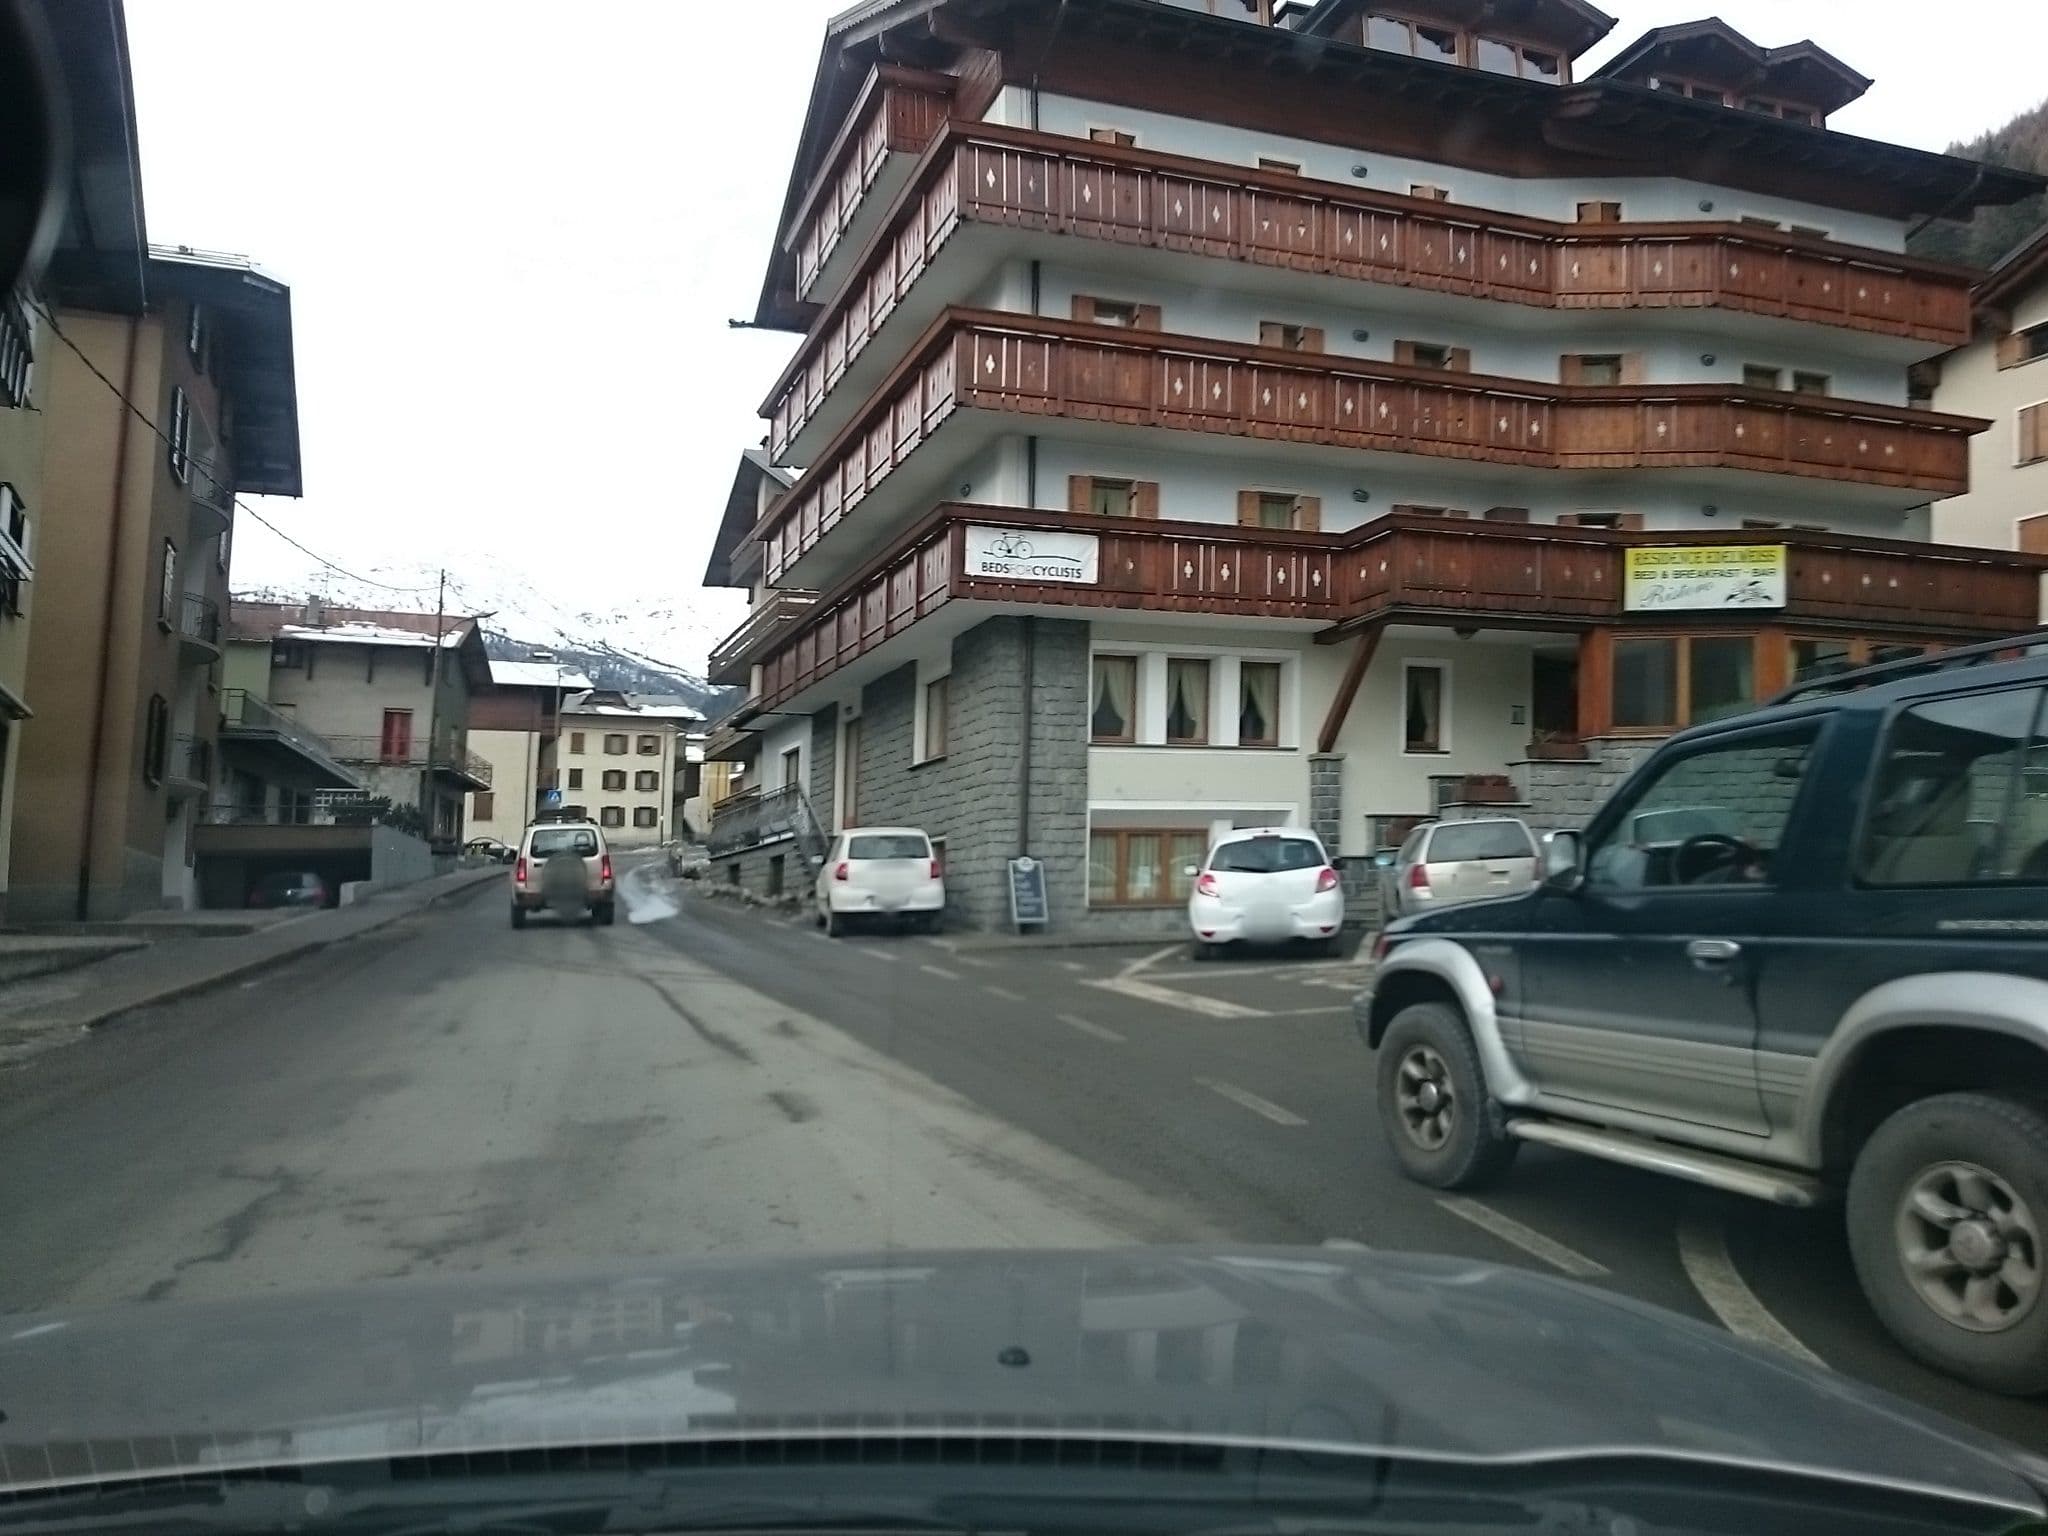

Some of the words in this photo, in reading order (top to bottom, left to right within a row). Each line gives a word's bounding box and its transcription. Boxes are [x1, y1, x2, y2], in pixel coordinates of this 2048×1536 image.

[1633, 569, 1657, 580] BED
[1672, 568, 1742, 579] BREAKFAST
[1752, 567, 1777, 578] BAR
